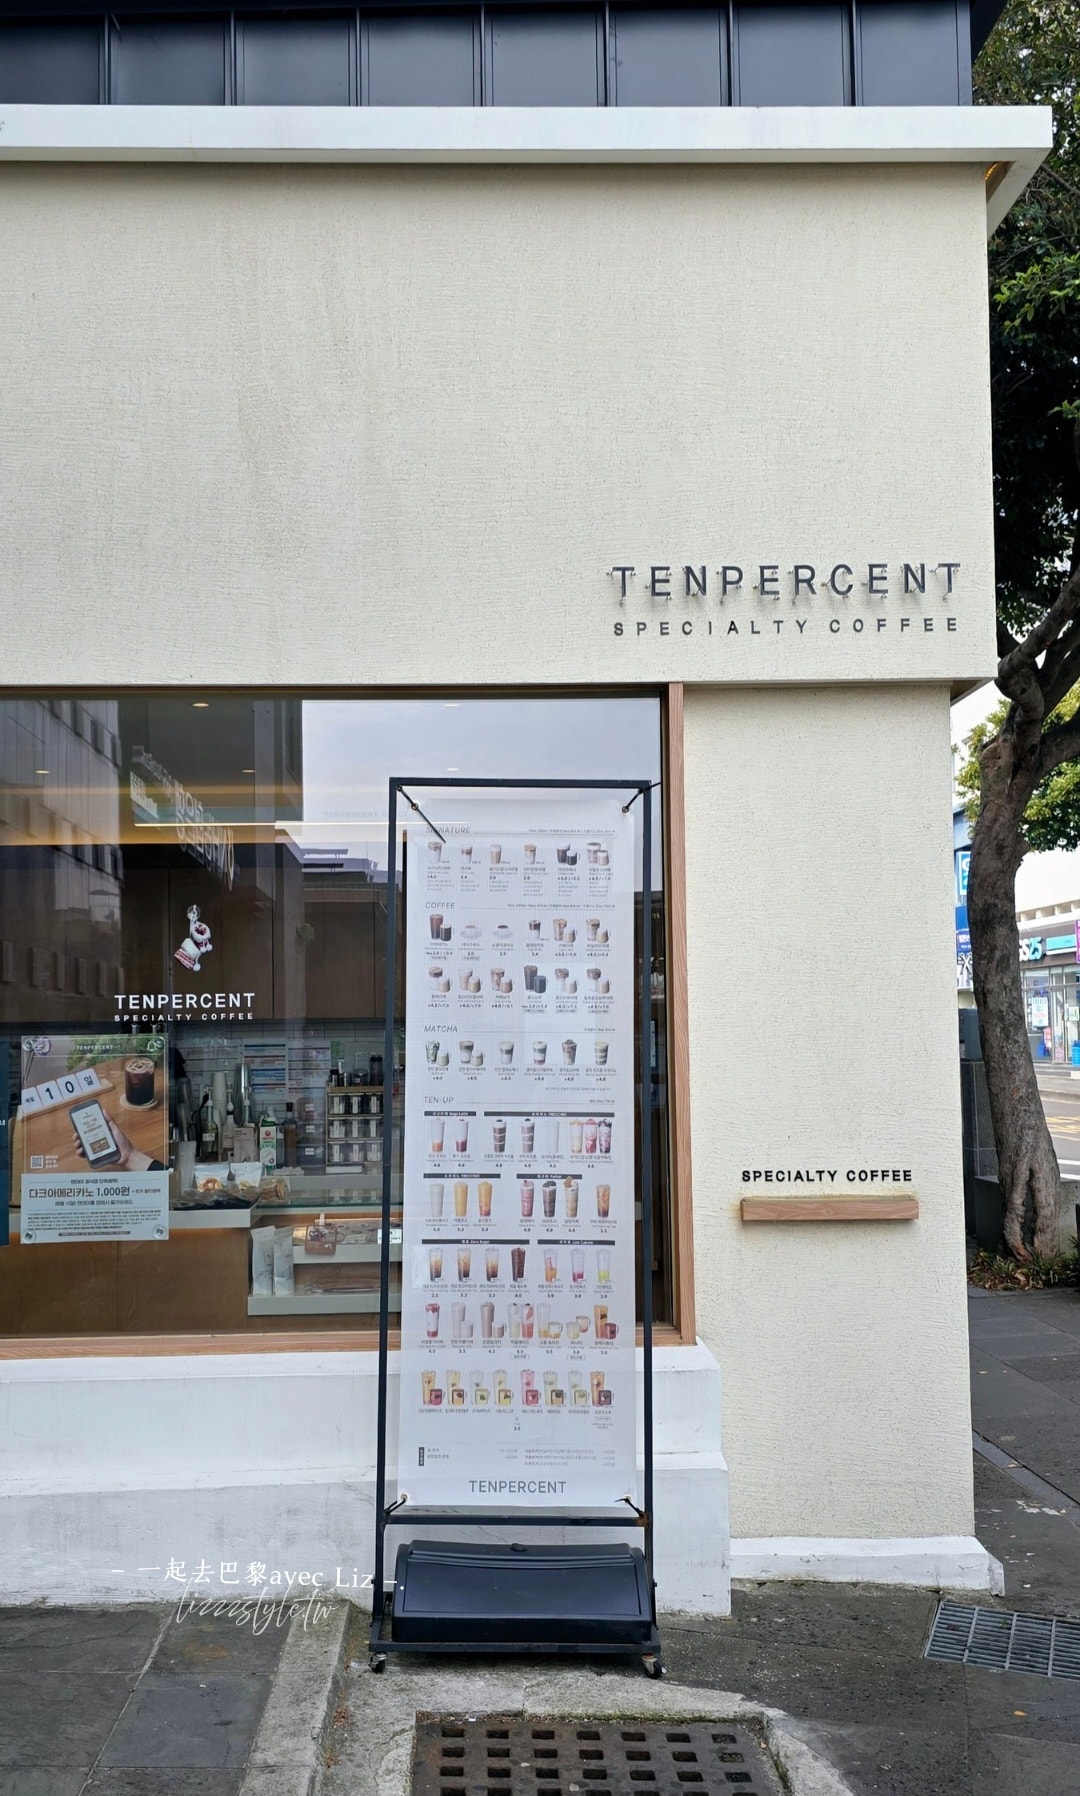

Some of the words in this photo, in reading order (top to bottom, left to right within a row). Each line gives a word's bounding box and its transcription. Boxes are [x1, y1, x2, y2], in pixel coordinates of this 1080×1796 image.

[611, 563, 961, 598] TENPERCENT
[613, 619, 808, 637] SPECIALTY
[828, 617, 958, 634] COFFEE
[425, 902, 456, 910] COFFEE
[114, 993, 256, 1010] TENPERCENT
[114, 1013, 193, 1022] SPECIALTY
[201, 1012, 254, 1021] COFFEE
[424, 1025, 458, 1033] MATCHA
[424, 1096, 454, 1104] TEN-UP
[741, 1169, 838, 1183] SPECIALTY
[846, 1169, 912, 1182] COFFEE
[29, 1188, 94, 1199] 다크아메리카노
[96, 1186, 130, 1197] 1,000원
[468, 1480, 567, 1494] TENPERCENT
